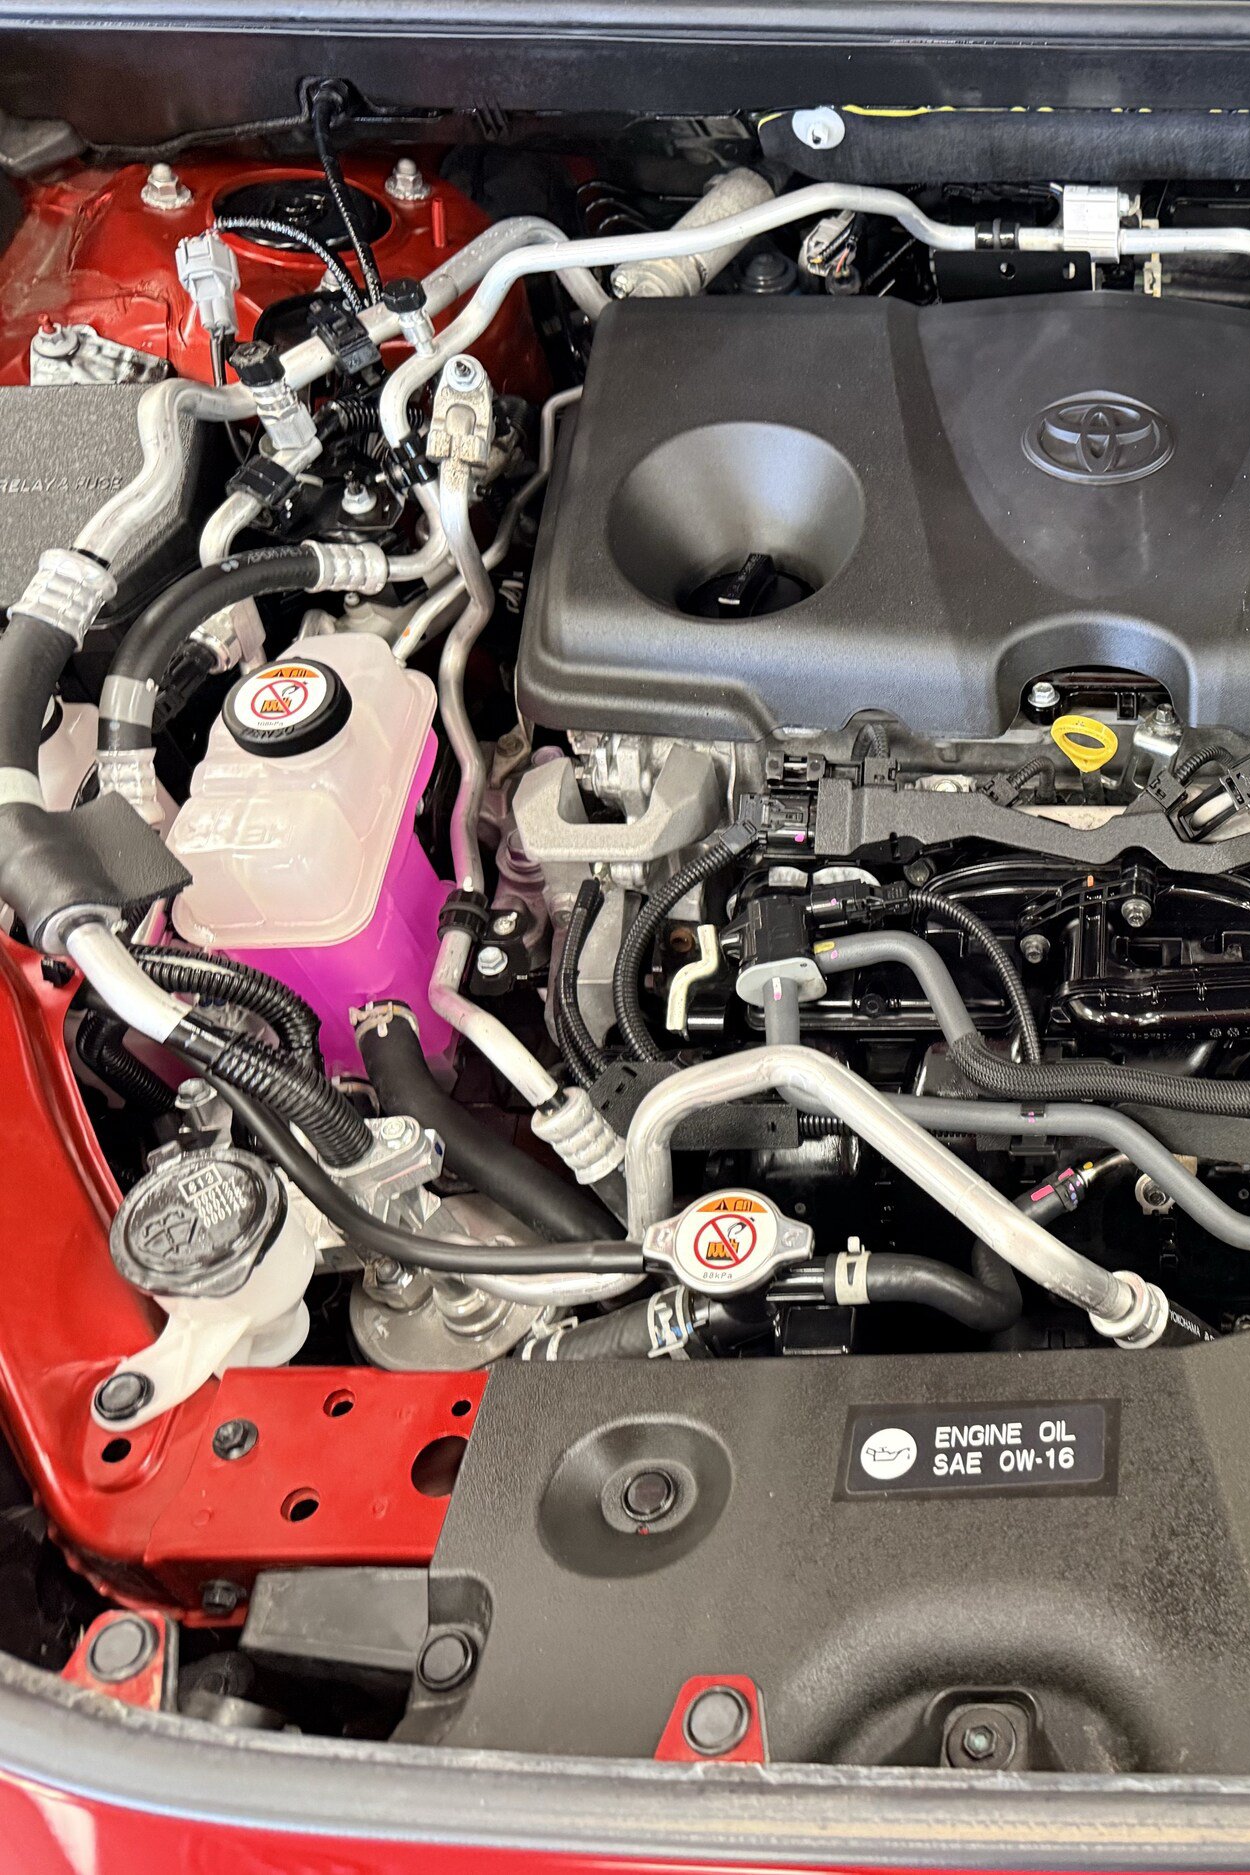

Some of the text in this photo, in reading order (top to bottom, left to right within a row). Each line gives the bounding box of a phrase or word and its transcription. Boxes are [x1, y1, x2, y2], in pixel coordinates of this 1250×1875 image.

[702, 1271, 733, 1280] 88kPa
[935, 1420, 1076, 1449] ENGINE OIL
[933, 1447, 1075, 1476] SAE 0W-16
